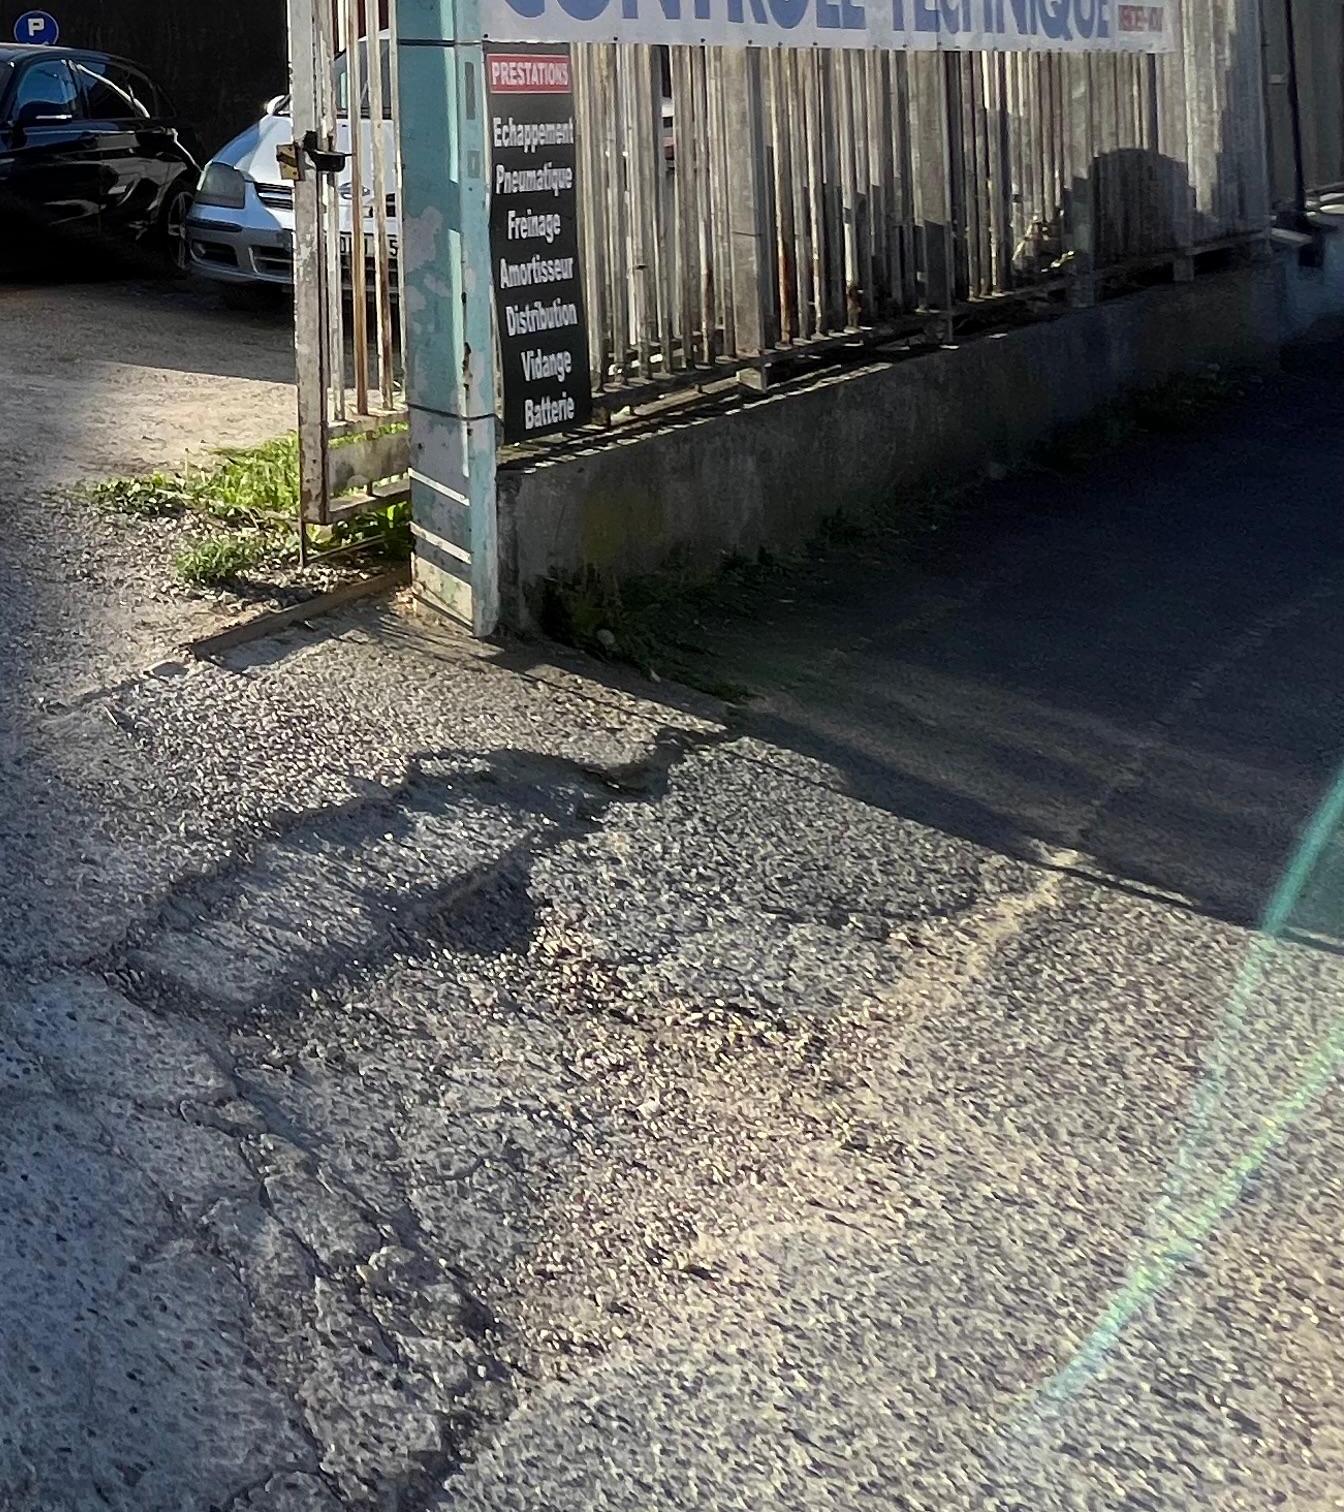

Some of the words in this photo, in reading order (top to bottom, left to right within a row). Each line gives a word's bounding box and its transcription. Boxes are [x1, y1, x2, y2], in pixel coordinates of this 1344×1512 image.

[27, 18, 44, 37] P
[491, 61, 569, 88] PRESTATIONS
[493, 117, 575, 153] Echappement
[496, 162, 573, 197] Pneumatique
[507, 209, 561, 244] Freinage
[500, 254, 574, 289] Amortisseur
[505, 298, 578, 337] Distribution
[520, 348, 572, 383] Vidange
[524, 395, 575, 430] Batterie
